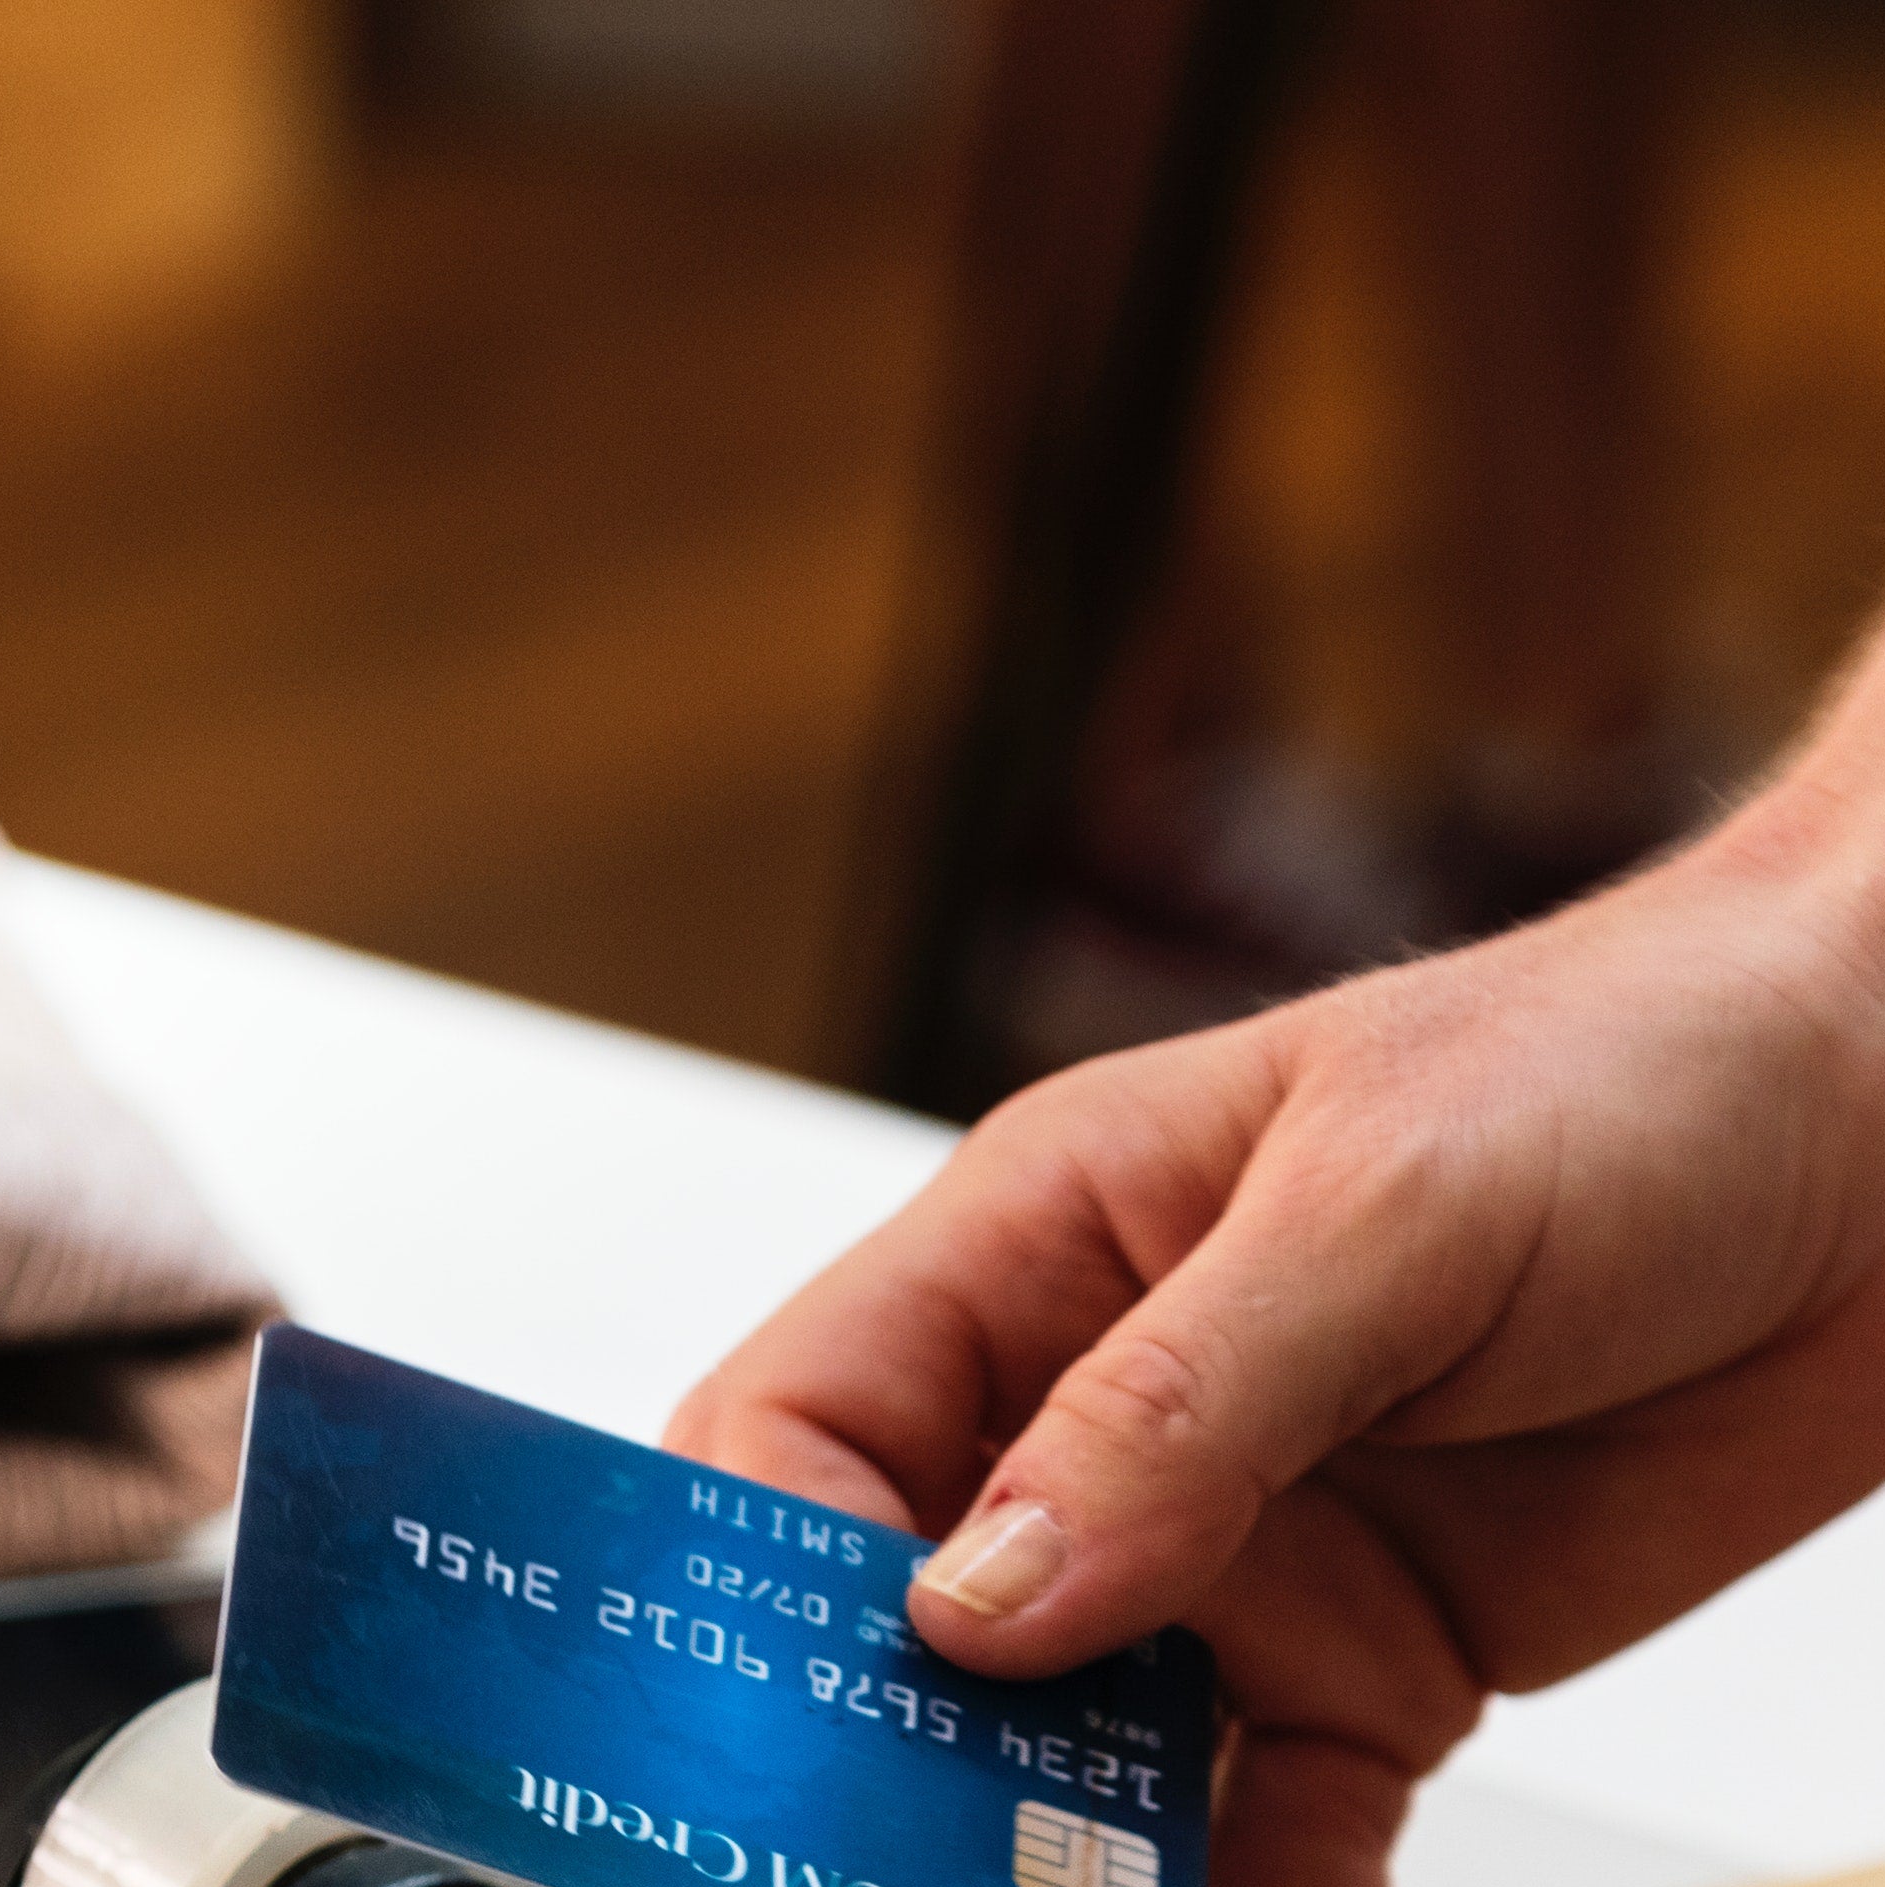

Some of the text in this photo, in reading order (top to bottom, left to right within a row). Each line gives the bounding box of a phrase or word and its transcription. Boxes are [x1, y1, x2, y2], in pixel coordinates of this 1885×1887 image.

[689, 1479, 867, 1566] SMITH
[686, 1553, 831, 1626] 07/20
[393, 1515, 1162, 1812] 1234 5678 9012 3456
[511, 1765, 749, 1881] Credit
